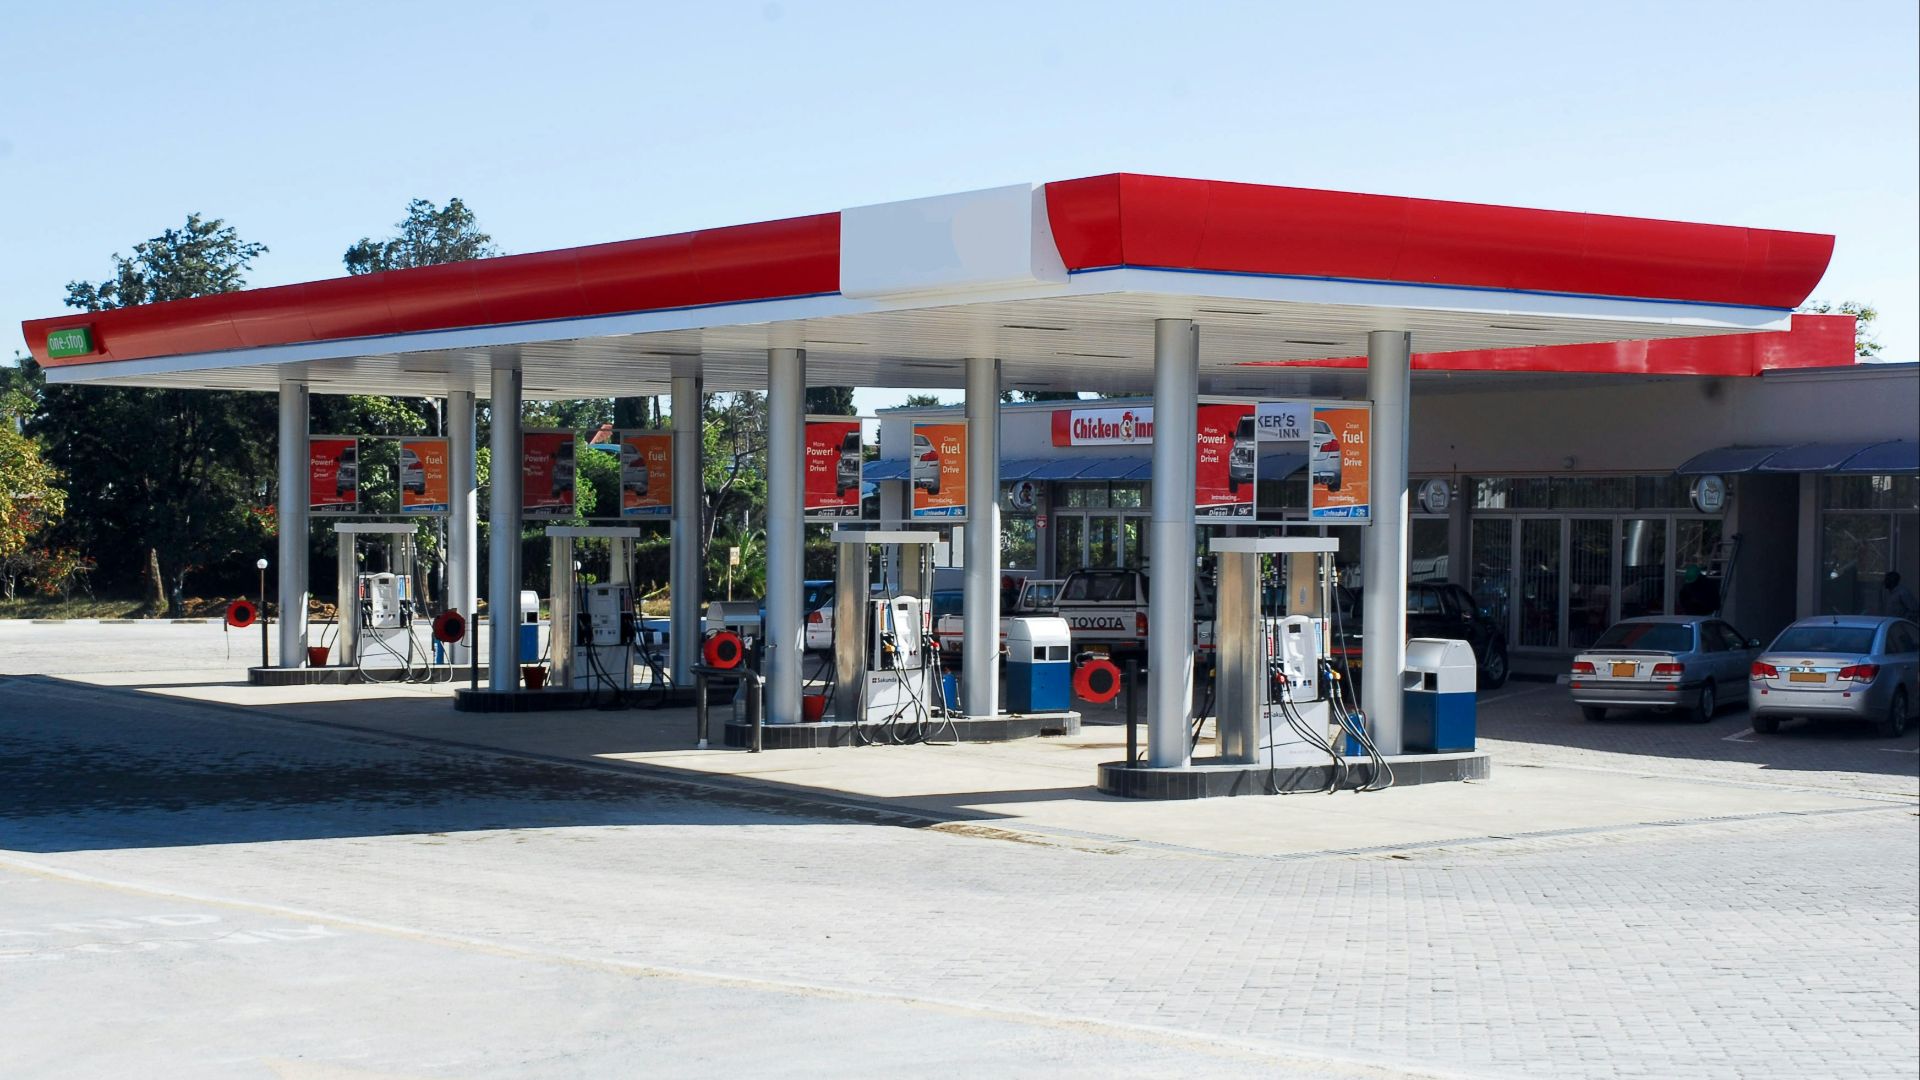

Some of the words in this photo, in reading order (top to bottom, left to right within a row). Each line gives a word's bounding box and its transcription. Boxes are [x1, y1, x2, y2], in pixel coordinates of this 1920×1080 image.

[49, 333, 84, 353] one-stop
[1073, 417, 1119, 439] Chicken
[1134, 416, 1153, 438] inn
[1278, 428, 1300, 438] INN
[1342, 431, 1364, 444] fuel
[1197, 433, 1226, 444] Power!
[806, 447, 833, 456] Power!
[940, 443, 961, 454] fuel
[425, 456, 443, 465] fuel
[525, 455, 550, 463] Power!
[648, 451, 666, 461] fuel
[1200, 455, 1219, 463] Drive!
[1343, 457, 1362, 466] Drive
[809, 464, 828, 472] Drive!
[942, 465, 960, 474] Drive
[1070, 617, 1124, 629] TOYOTA
